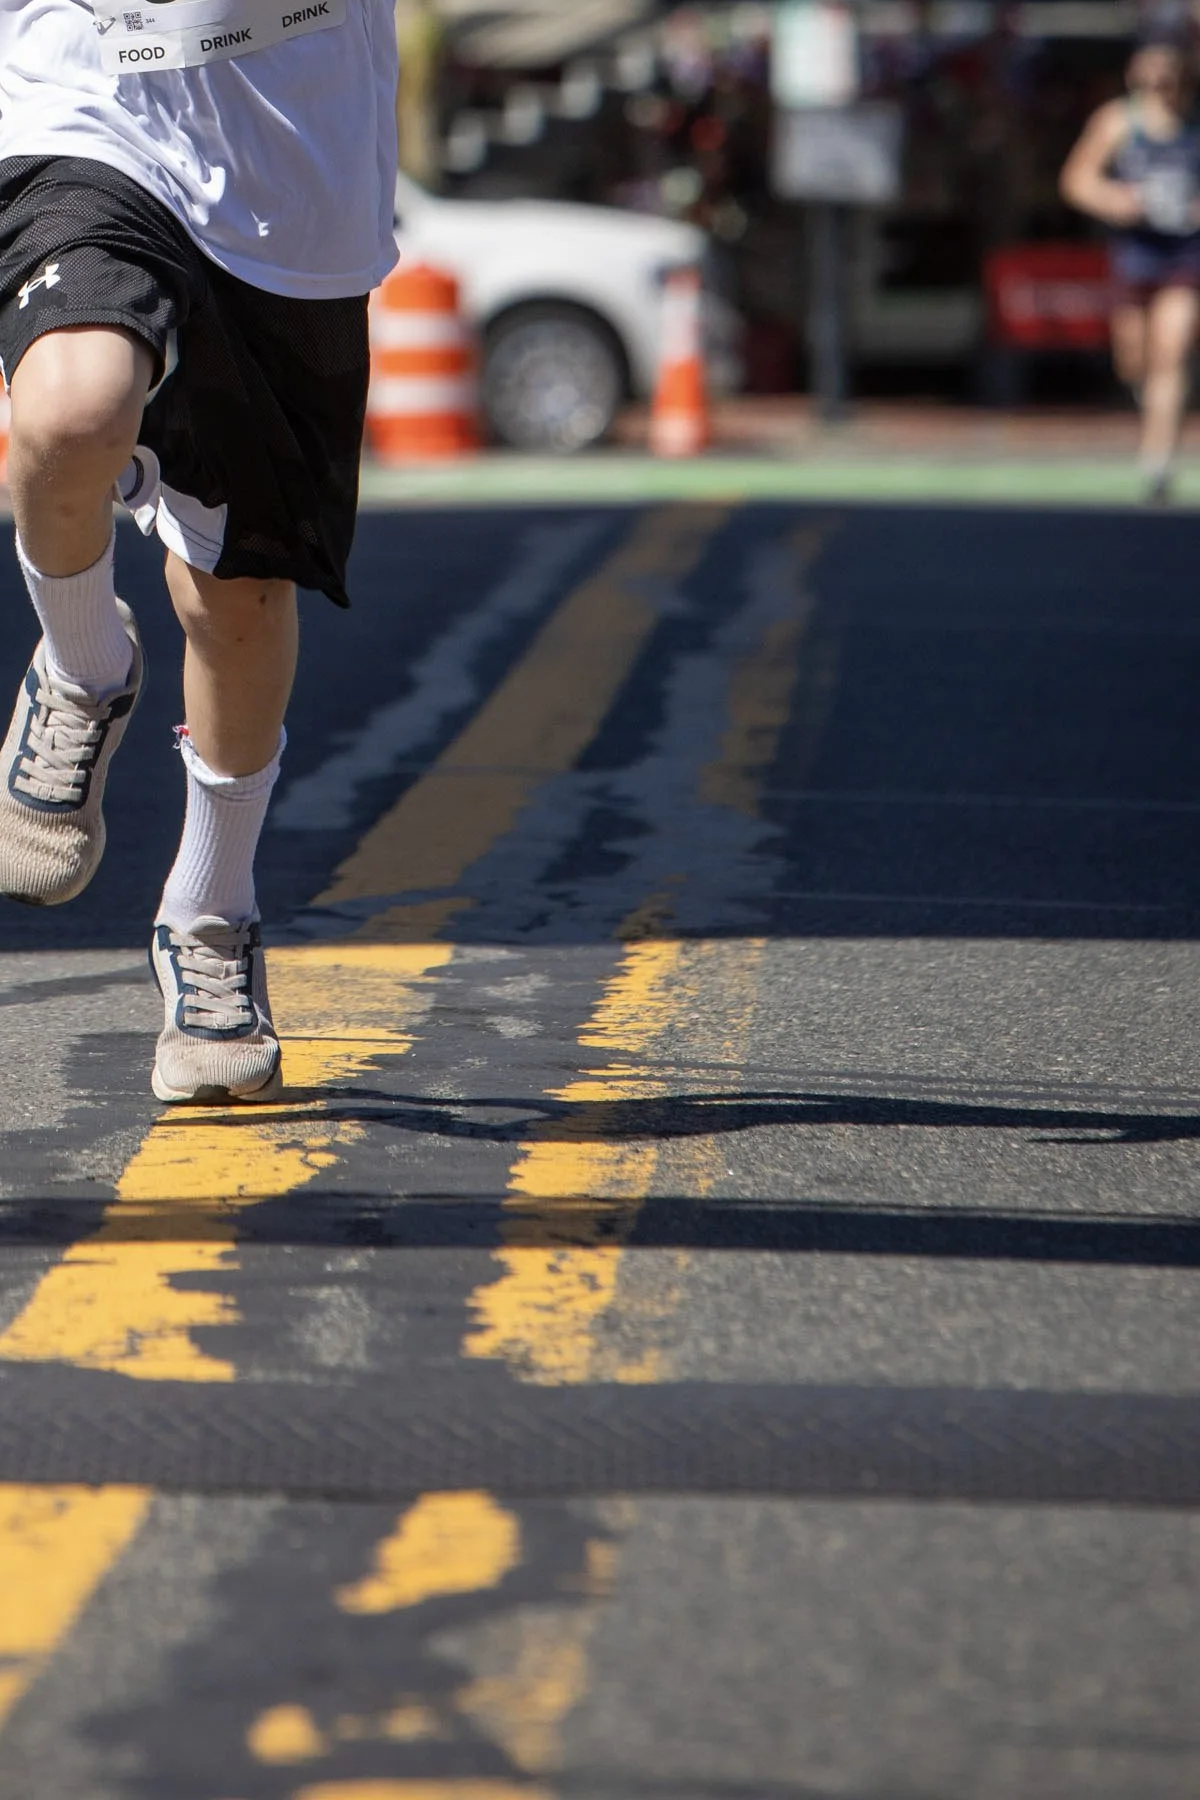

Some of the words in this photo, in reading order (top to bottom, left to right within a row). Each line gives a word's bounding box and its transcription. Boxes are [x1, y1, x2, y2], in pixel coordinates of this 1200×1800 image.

[281, 2, 330, 28] DRINK
[200, 28, 253, 52] DRINK
[118, 46, 166, 63] FOOD
